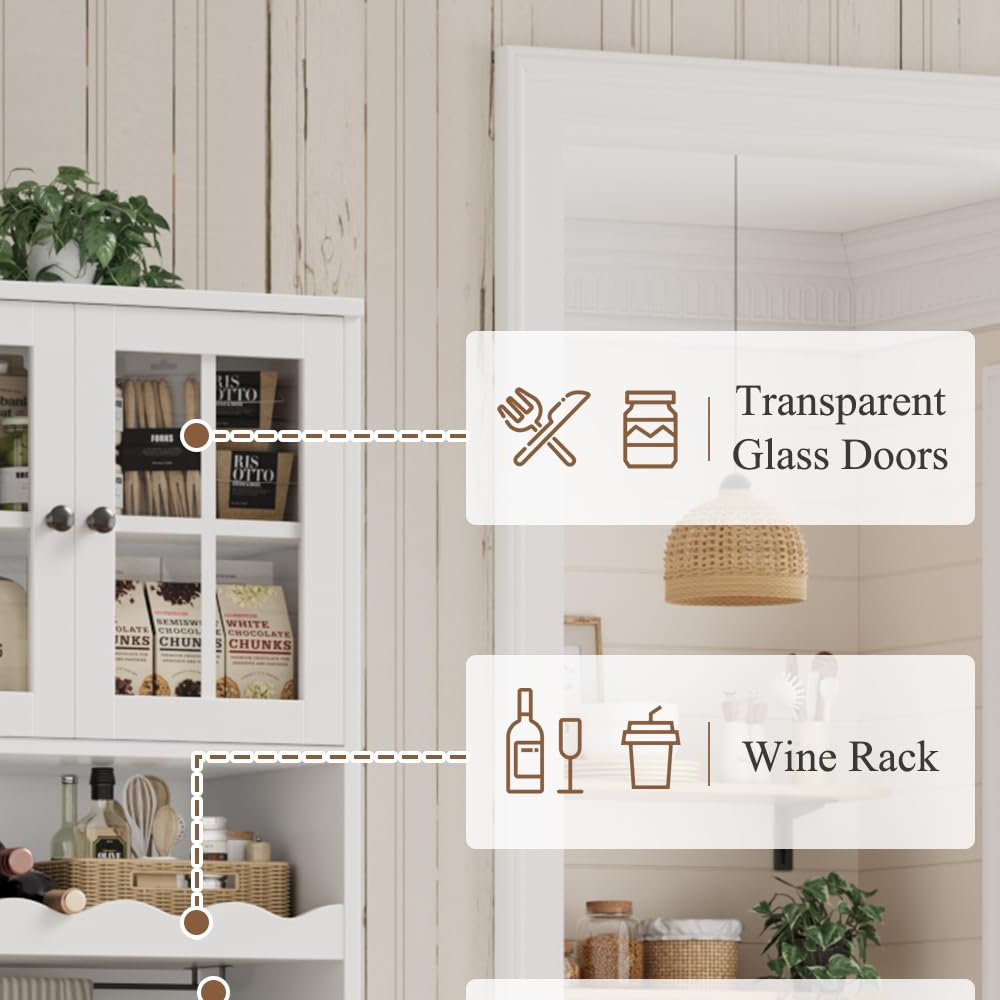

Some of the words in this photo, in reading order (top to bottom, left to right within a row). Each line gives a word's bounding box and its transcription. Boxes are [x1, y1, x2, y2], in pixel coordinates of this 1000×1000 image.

[234, 454, 259, 469] RIS
[232, 468, 275, 482] OTTO
[227, 619, 270, 628] WHITE
[115, 626, 149, 634] OLATE
[228, 629, 291, 638] CHOCOLATE
[229, 639, 292, 651] CHUNKS
